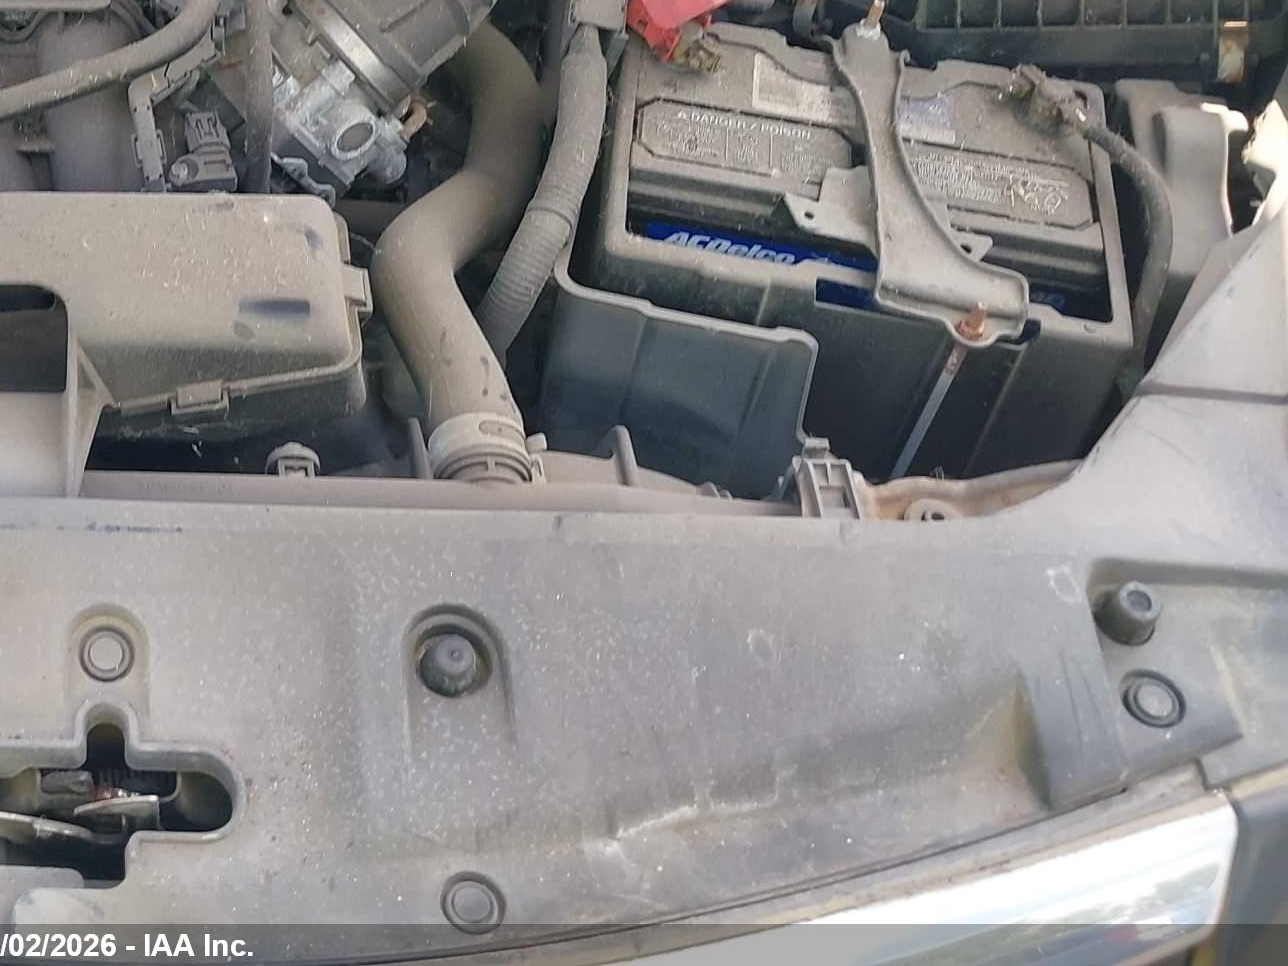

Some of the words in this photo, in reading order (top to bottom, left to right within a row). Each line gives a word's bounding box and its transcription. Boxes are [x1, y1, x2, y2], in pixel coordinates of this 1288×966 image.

[690, 111, 746, 130] DANGER
[760, 123, 812, 140] POISON
[663, 231, 796, 265] ACDelco
